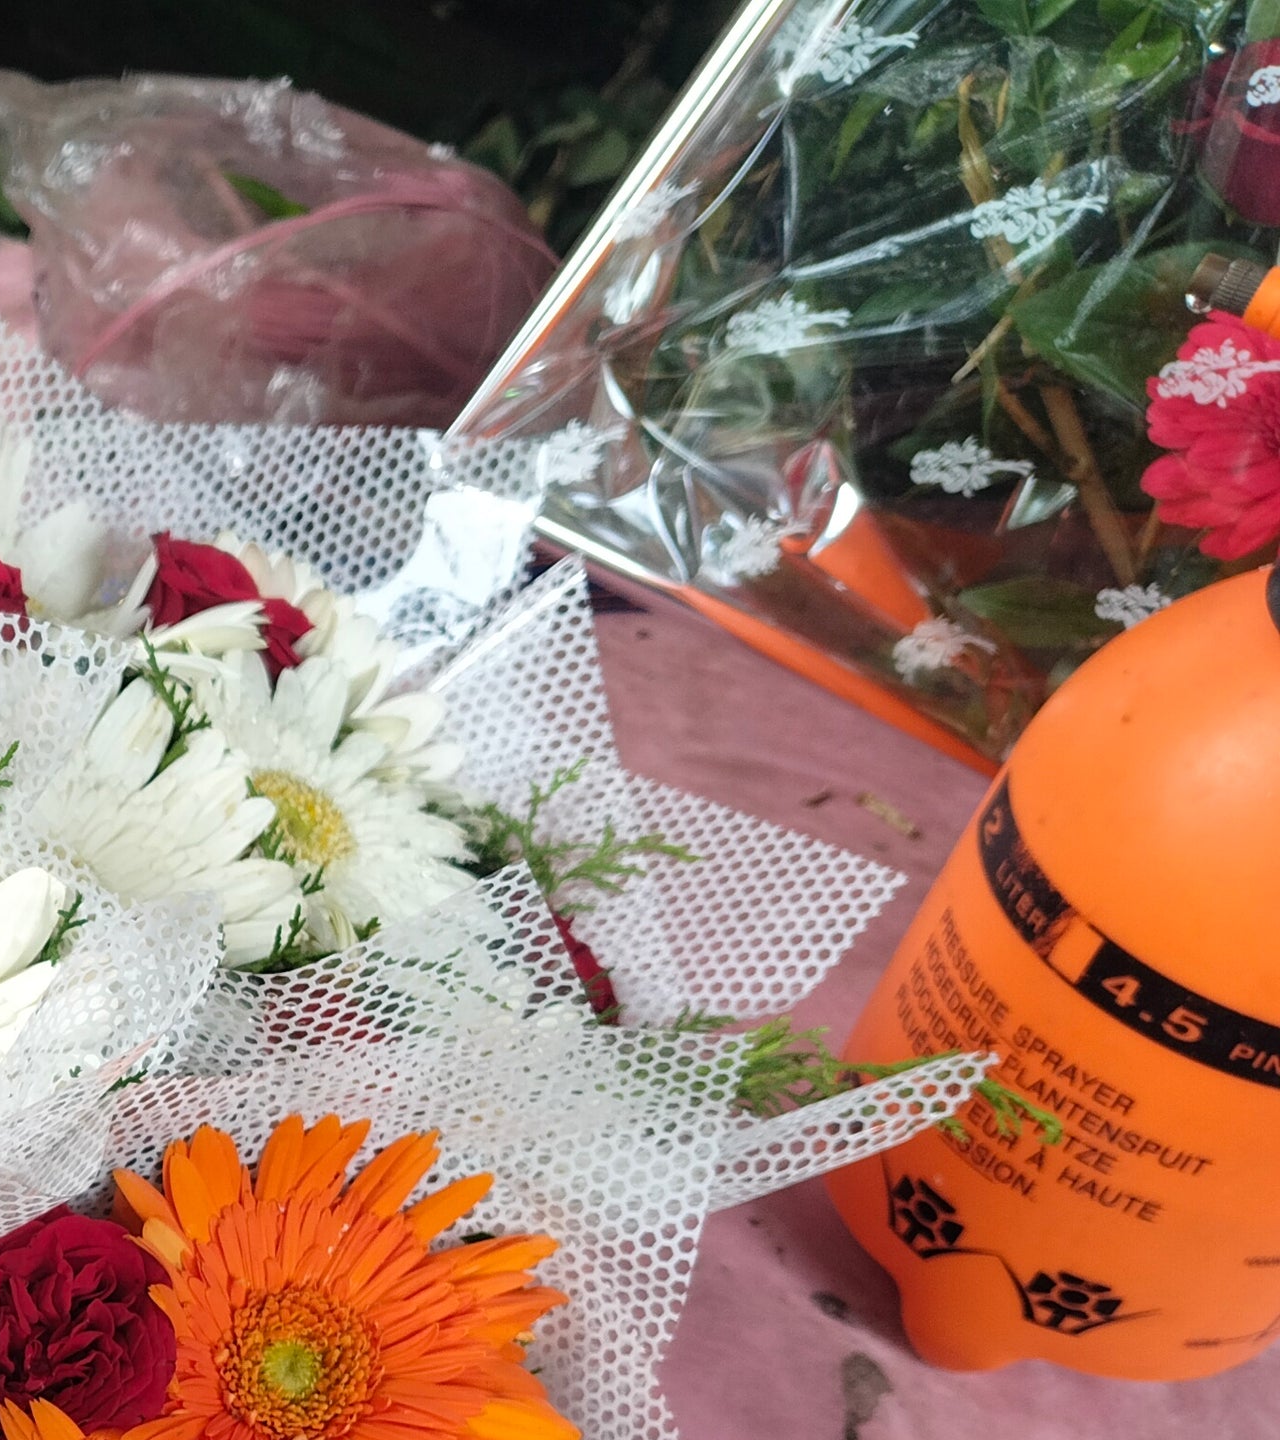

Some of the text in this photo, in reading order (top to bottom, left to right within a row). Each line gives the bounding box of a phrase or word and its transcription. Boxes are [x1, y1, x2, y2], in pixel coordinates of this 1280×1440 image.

[940, 906, 1136, 1117] PRESSURE SPRAYER
[1101, 975, 1209, 1043] 4.5
[1000, 1053, 1214, 1176] PLANTENSPUIT
[1056, 1166, 1164, 1223] HAUTE
